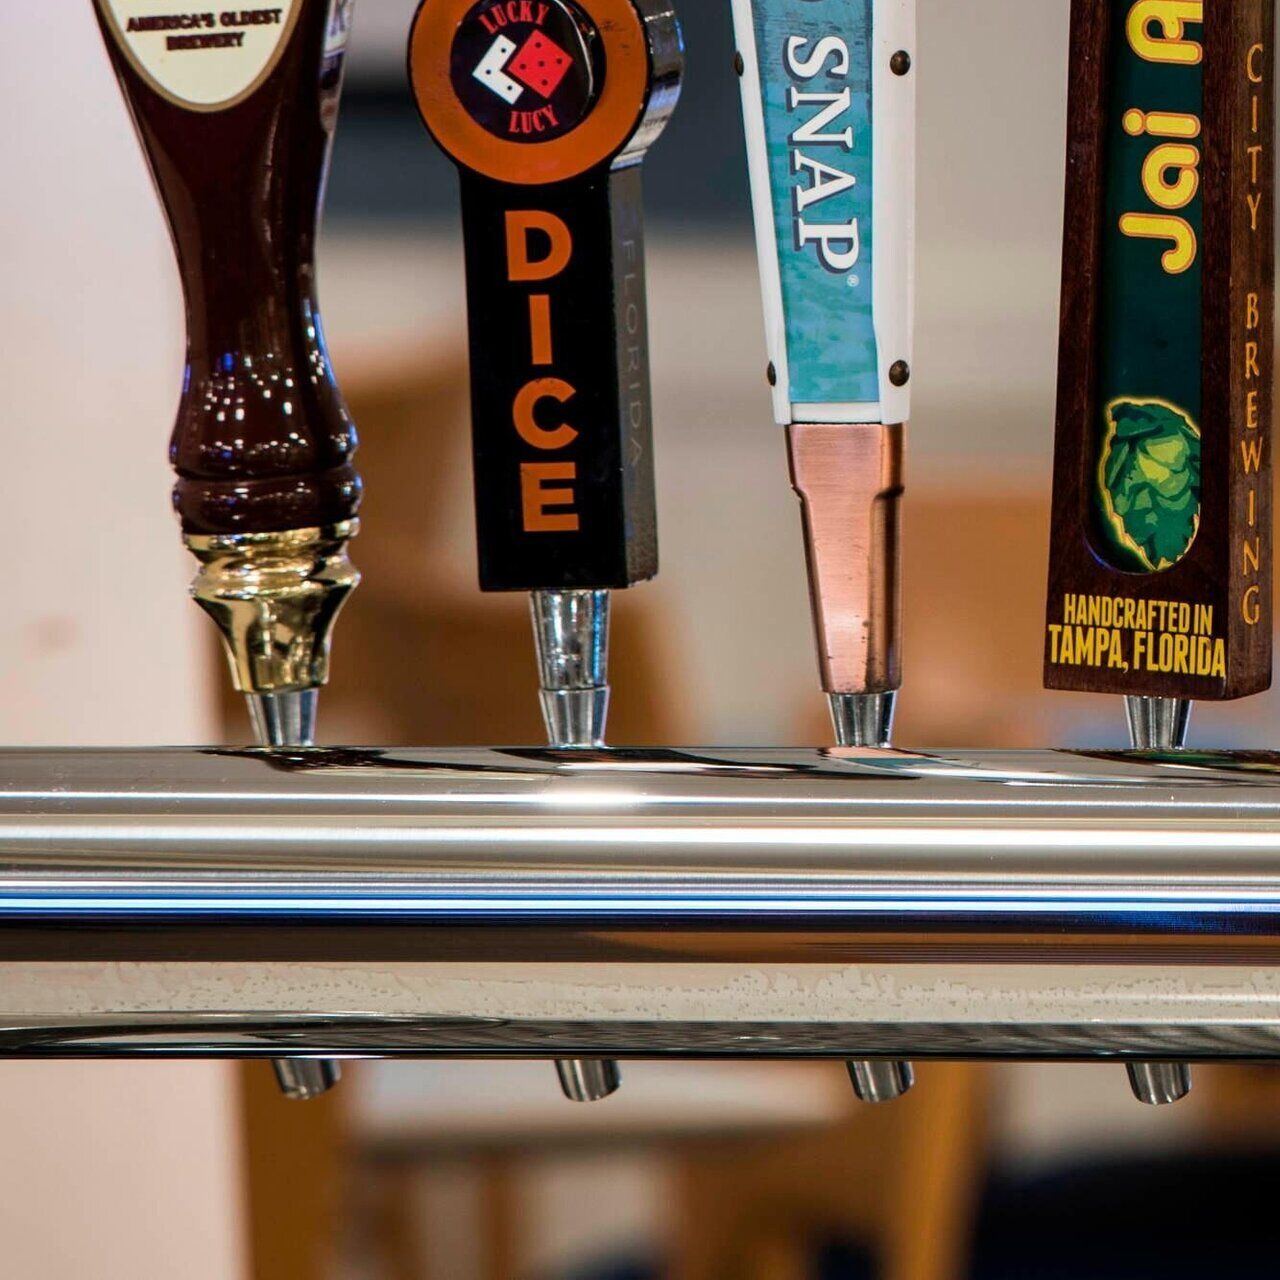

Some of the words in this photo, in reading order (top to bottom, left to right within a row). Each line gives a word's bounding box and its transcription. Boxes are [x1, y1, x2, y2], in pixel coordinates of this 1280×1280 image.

[478, 0, 549, 34] LUCKY
[508, 104, 559, 134] LUCY
[781, 34, 859, 272] SNAP
[1119, 108, 1201, 274] Jai
[1246, 43, 1264, 232] CITY
[504, 210, 580, 532] DICE
[621, 237, 647, 467] FLORIDA
[1241, 292, 1263, 626] BREWING
[1049, 624, 1129, 674] TAMPA,
[1133, 632, 1226, 678] FLORIDA
[1064, 594, 1191, 634] HANDCRAFTED
[1193, 604, 1213, 635] IN
